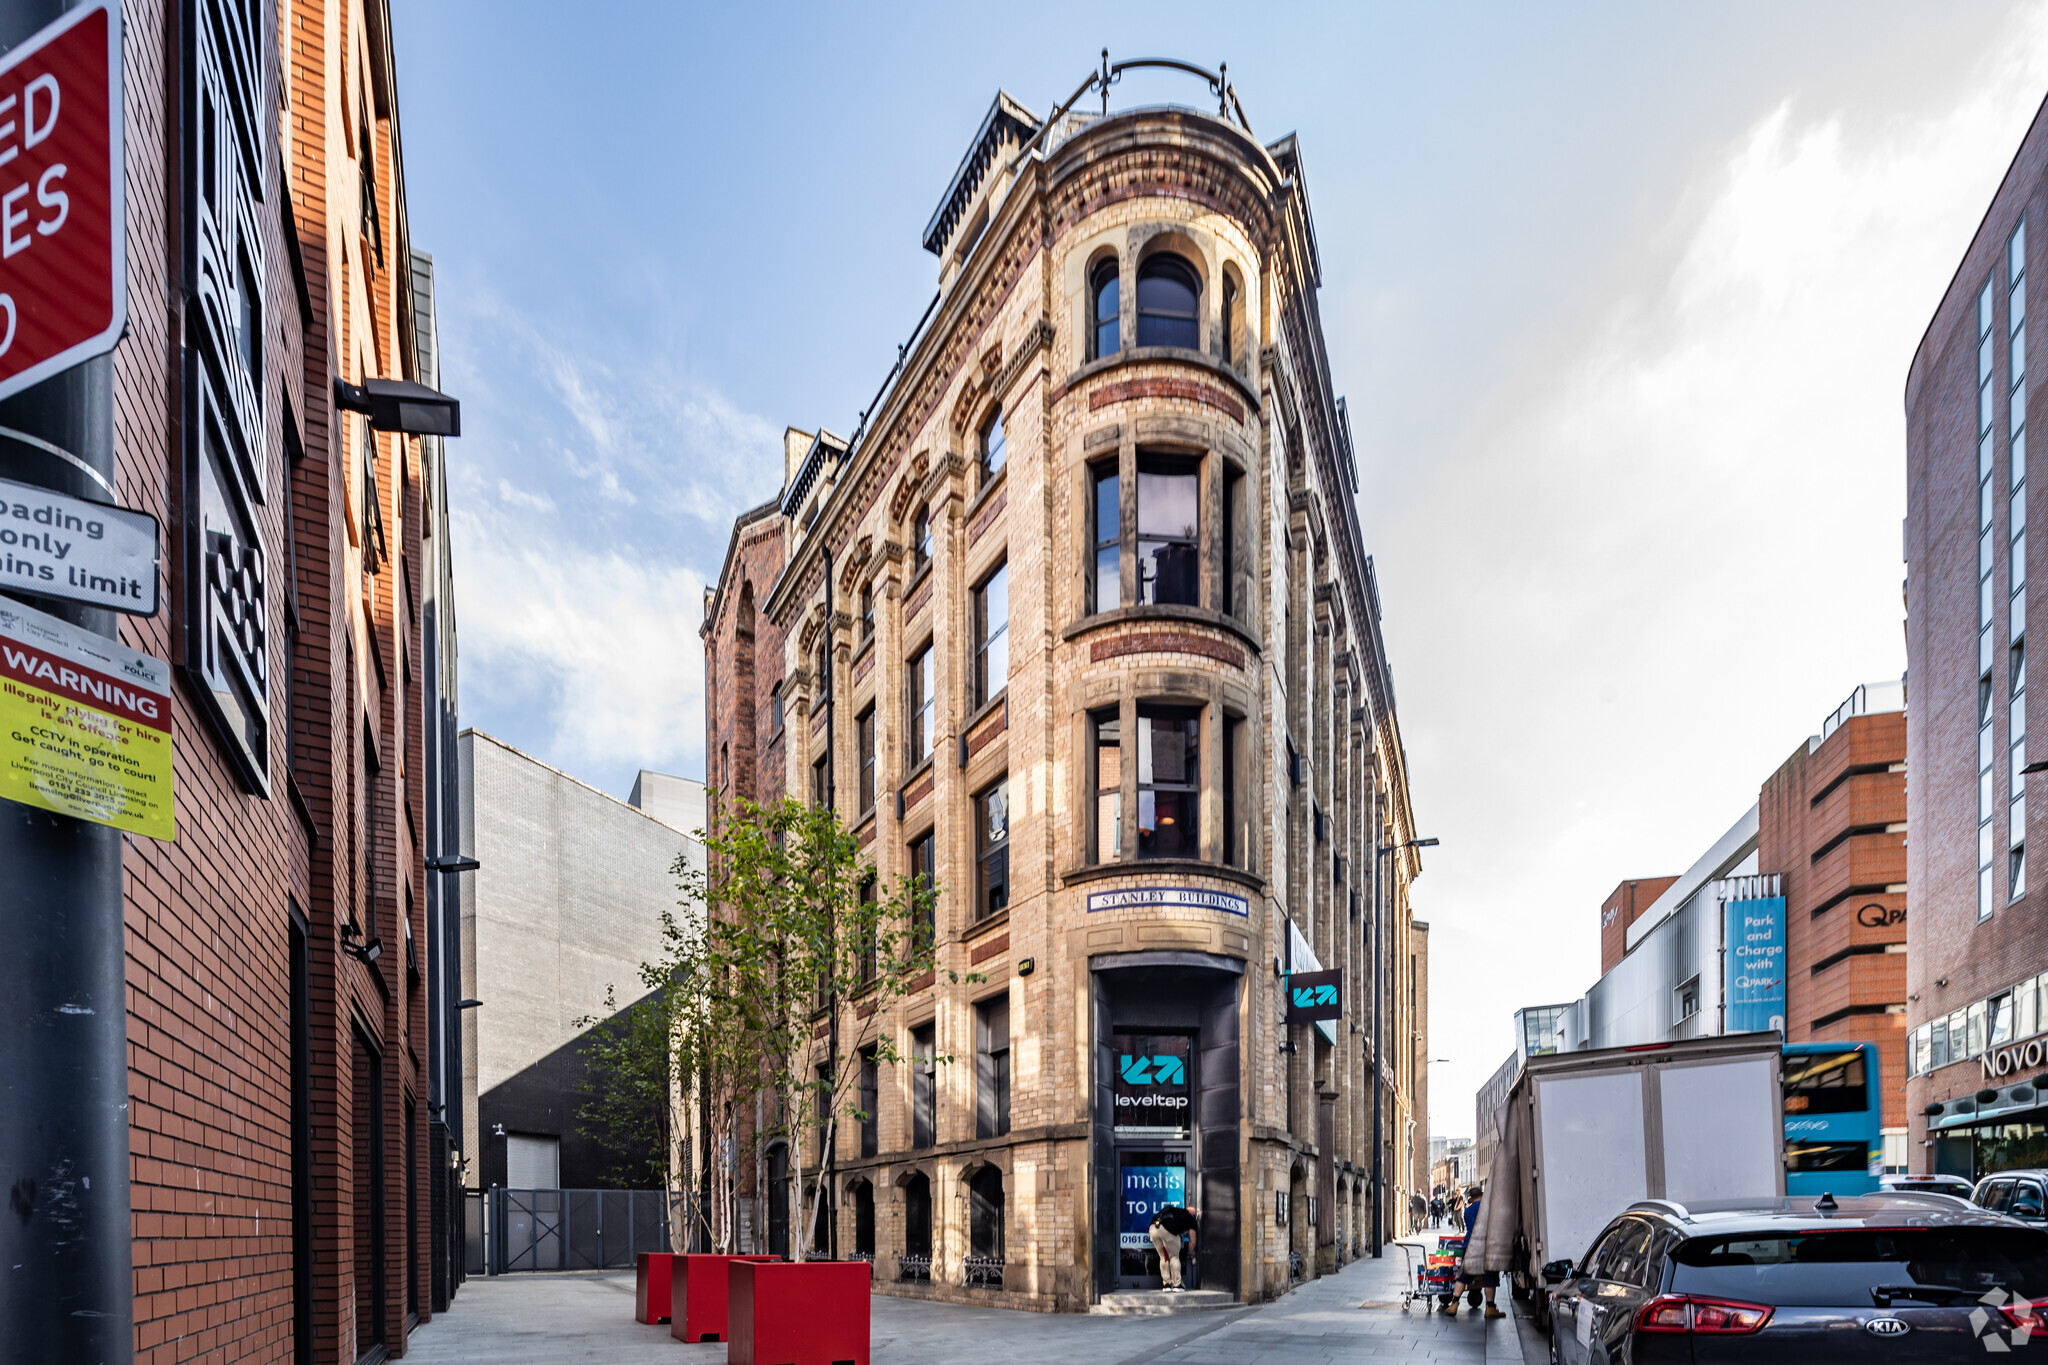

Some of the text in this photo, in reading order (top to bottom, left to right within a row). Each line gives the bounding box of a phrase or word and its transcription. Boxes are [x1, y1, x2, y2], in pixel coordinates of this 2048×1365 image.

[2, 163, 70, 260] ES
[0, 528, 72, 560] only
[0, 552, 142, 600] ins limit
[2, 644, 159, 719] WARNING
[124, 664, 156, 682] POLICE
[3, 682, 161, 744] Illegally plying for hire
[41, 708, 130, 745] is an offence
[30, 725, 140, 768] CCTV in operation
[11, 731, 157, 783] Get caught, go to court!
[10, 760, 159, 809] Liverpool City Council Licensing on
[23, 756, 148, 798] For more information contact
[48, 779, 72, 791] 0151
[74, 786, 92, 797] 233
[29, 781, 145, 820] licensing@liverpool.gov.uk
[1101, 891, 1241, 911] STANLEY BUILDINGS
[1744, 914, 1775, 927] Park
[1746, 928, 1772, 942] and
[1735, 945, 1783, 957] Charge
[1745, 957, 1773, 970] with
[1115, 1093, 1189, 1110] leveltap
[1127, 1172, 1181, 1190] metis
[1126, 1201, 1148, 1215] TO
[1121, 1235, 1141, 1244] 0161
[1873, 1322, 1903, 1333] KIA
